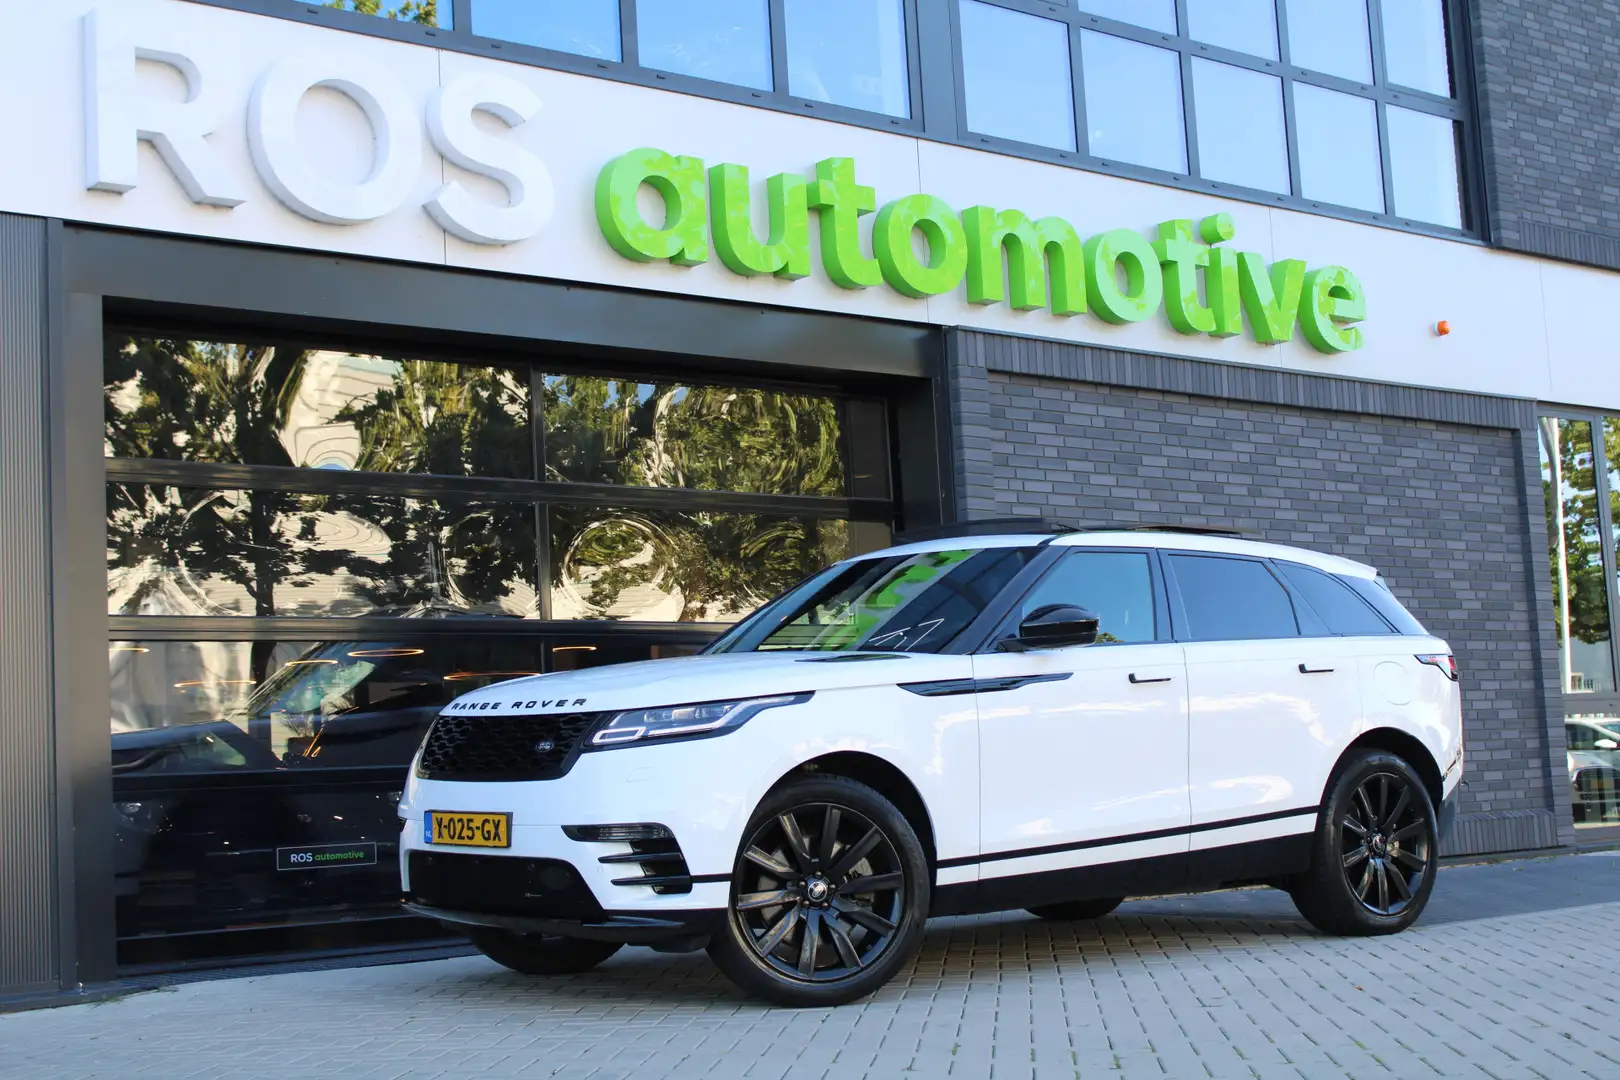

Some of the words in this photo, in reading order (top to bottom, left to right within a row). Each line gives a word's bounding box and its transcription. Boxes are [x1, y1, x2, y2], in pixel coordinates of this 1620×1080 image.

[83, 9, 555, 246] ROS
[595, 148, 1367, 354] automotive
[451, 702, 502, 711] RANGE
[511, 698, 587, 709] ROVER
[435, 817, 502, 842] X-025-GX
[290, 852, 313, 863] ROS
[314, 850, 364, 861] automotive
